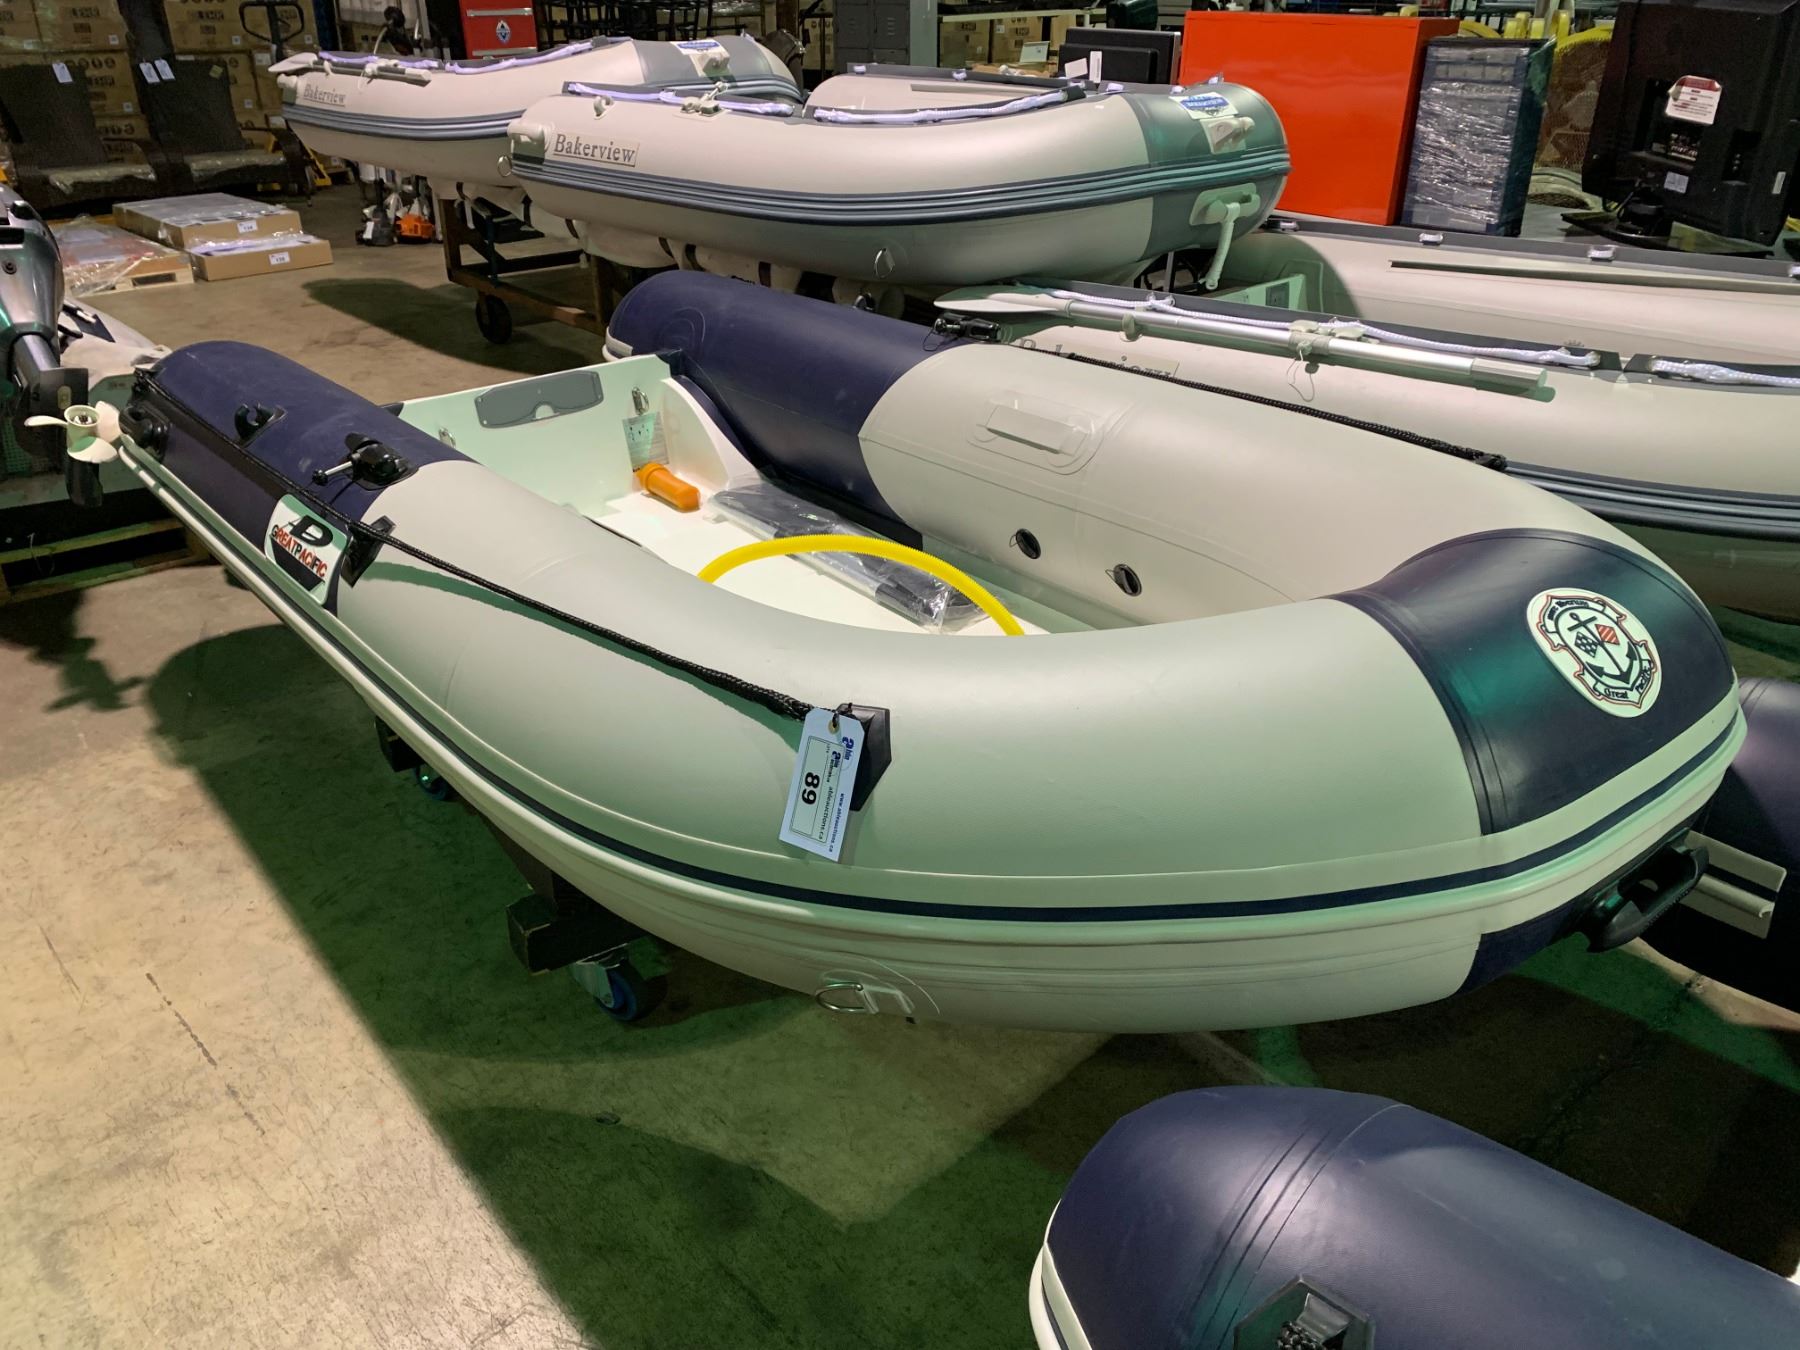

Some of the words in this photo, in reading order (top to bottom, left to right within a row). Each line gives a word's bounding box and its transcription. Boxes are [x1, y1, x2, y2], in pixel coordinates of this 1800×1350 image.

[304, 84, 345, 104] Bakerview
[554, 133, 635, 162] Bakerview
[802, 772, 820, 804] 89
